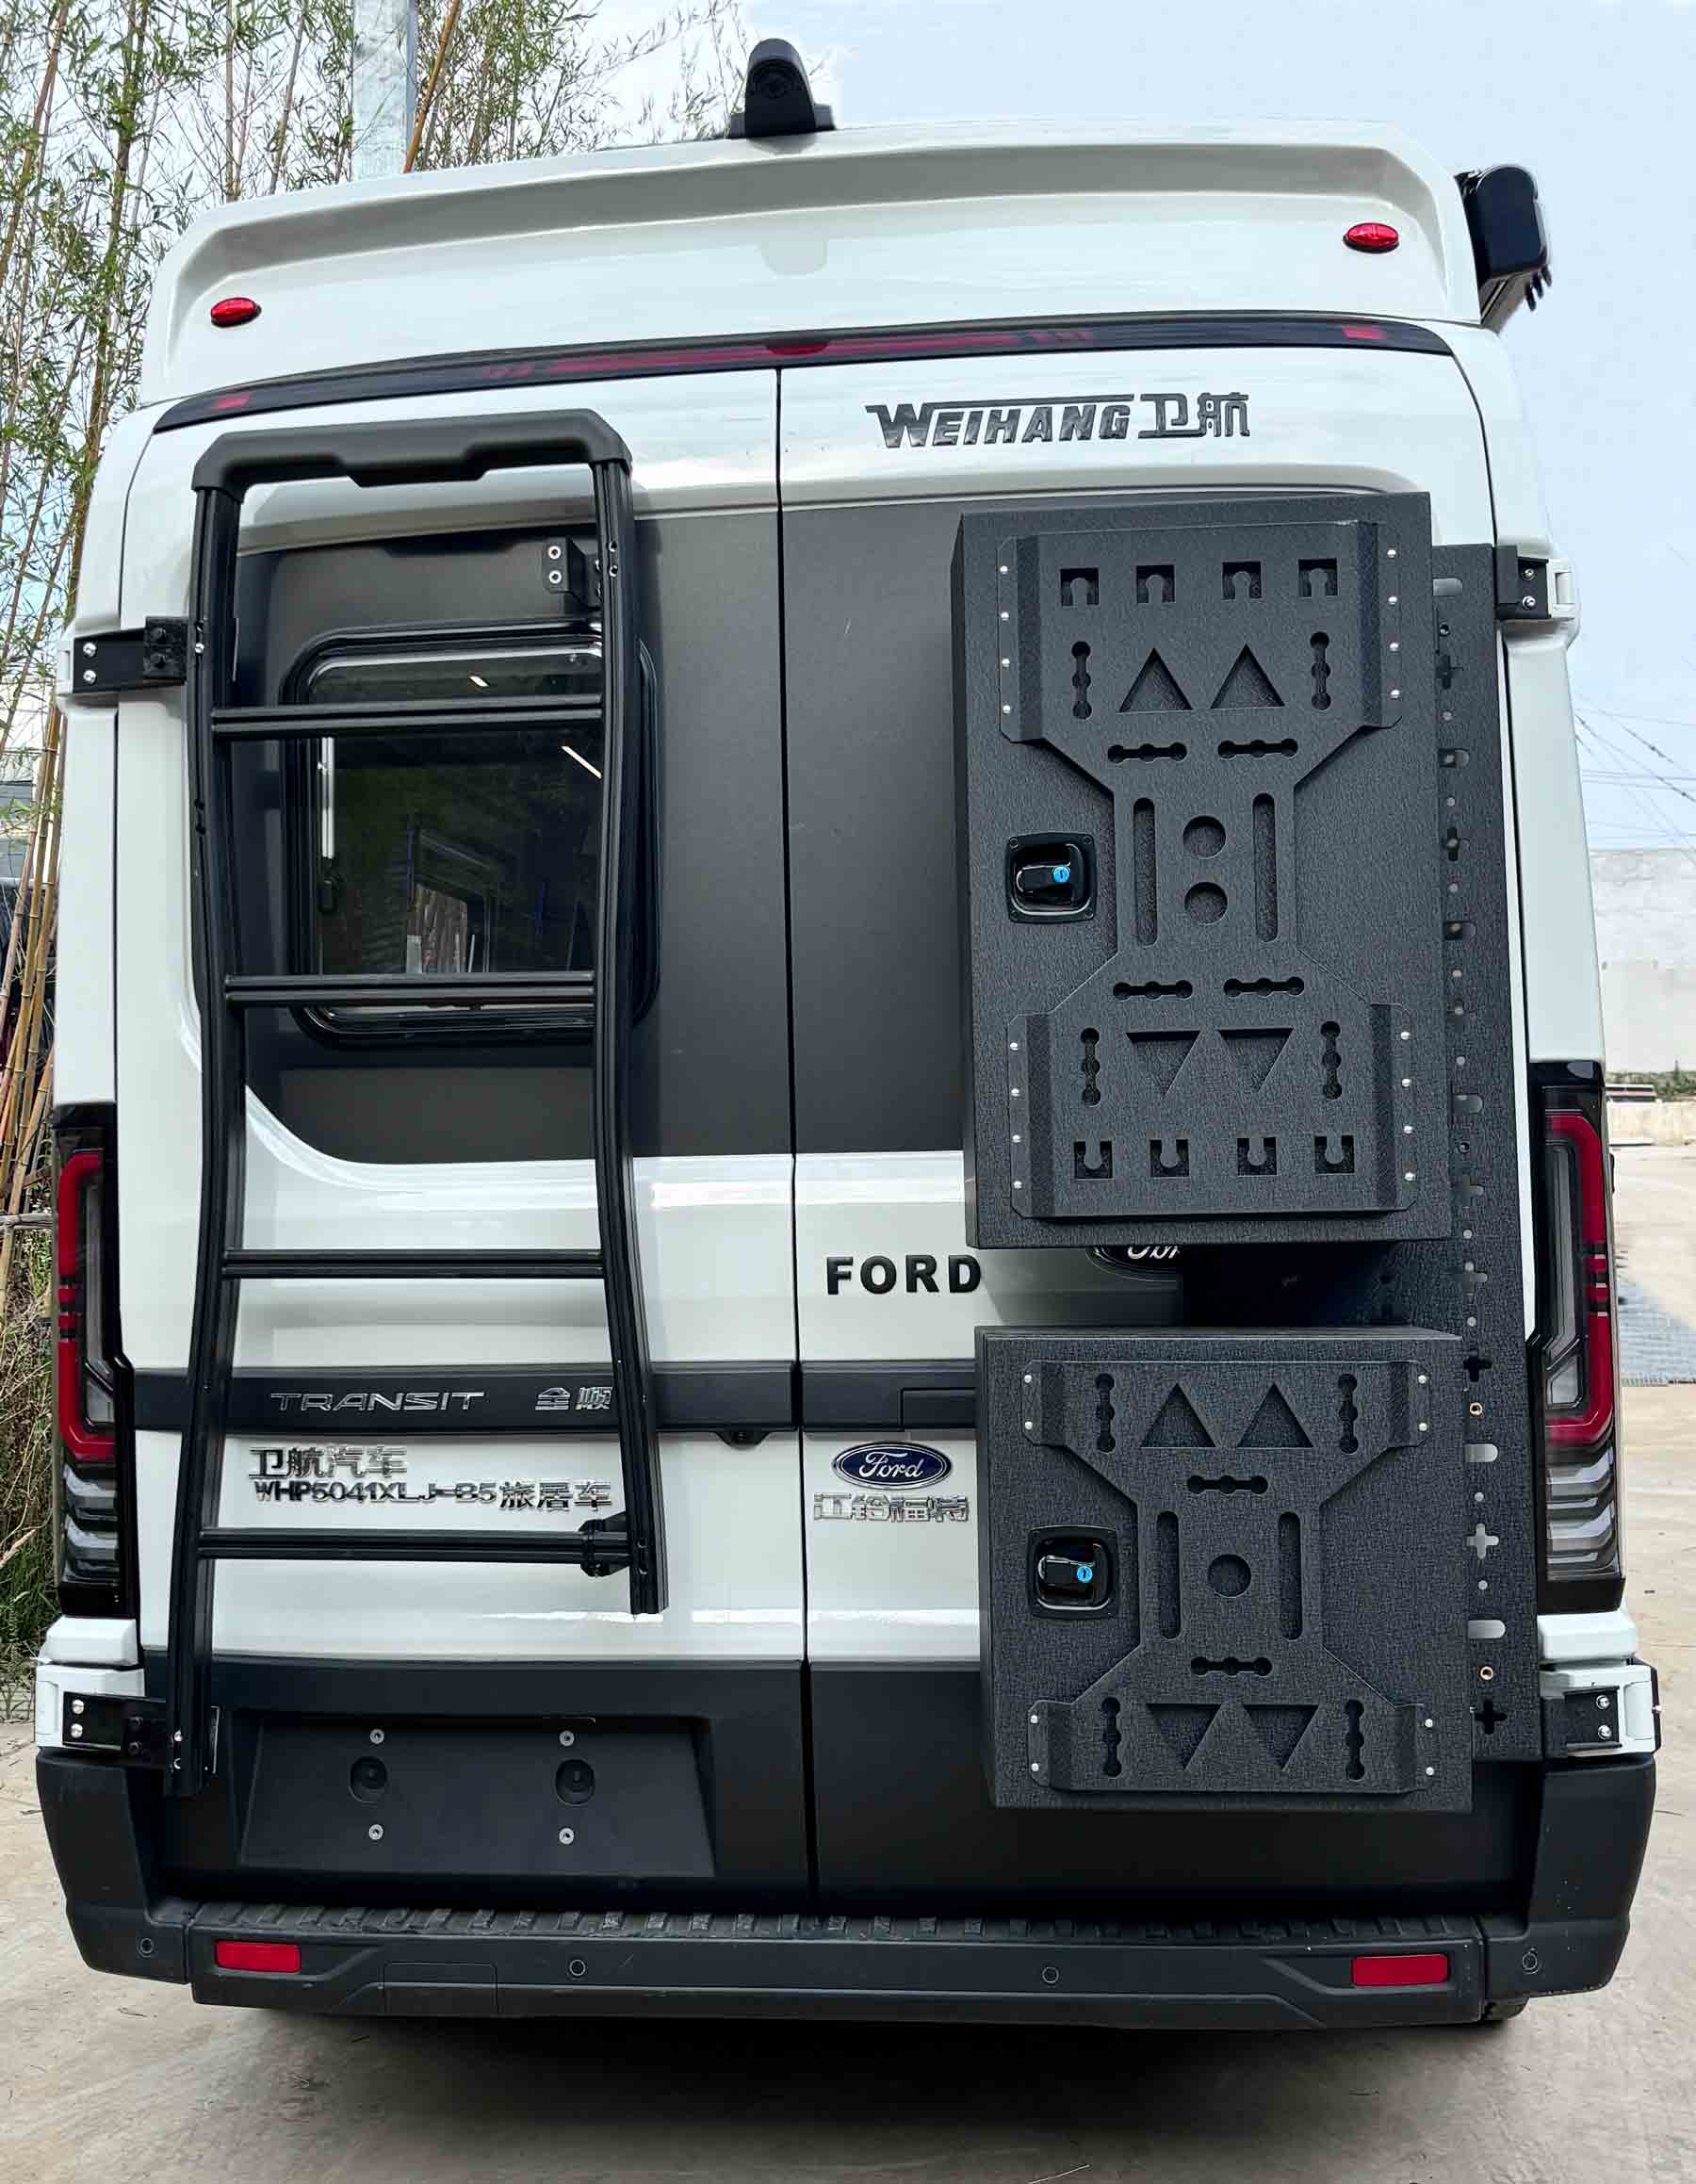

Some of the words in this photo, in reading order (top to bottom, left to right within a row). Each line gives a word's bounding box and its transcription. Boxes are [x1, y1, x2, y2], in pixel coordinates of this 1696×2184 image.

[826, 1254, 981, 1295] FORD
[270, 1392, 484, 1411] TRANSIT
[249, 1445, 408, 1479] 卫航汽车
[858, 1451, 925, 1477] Ford
[813, 1492, 970, 1523] 江铃福特
